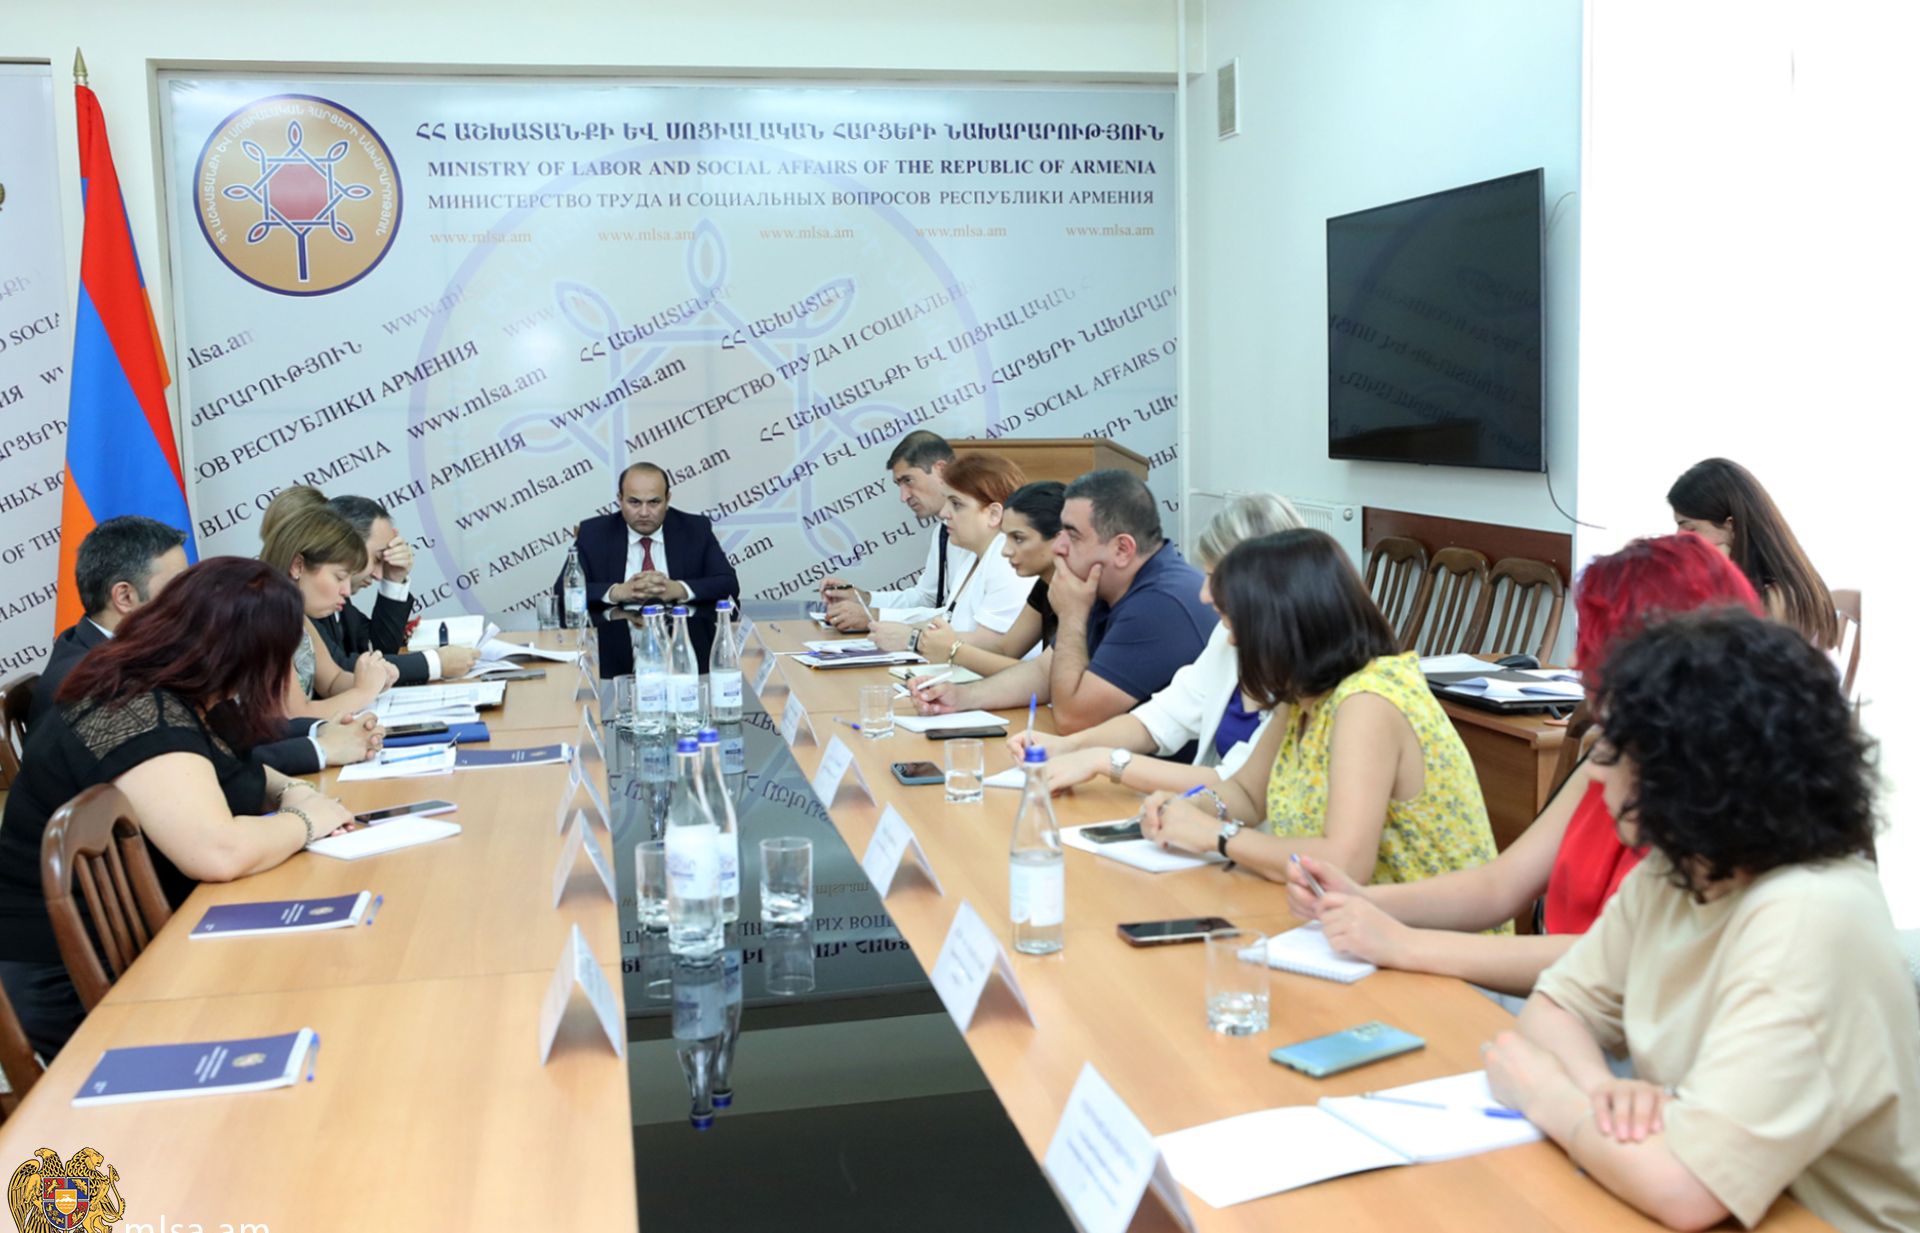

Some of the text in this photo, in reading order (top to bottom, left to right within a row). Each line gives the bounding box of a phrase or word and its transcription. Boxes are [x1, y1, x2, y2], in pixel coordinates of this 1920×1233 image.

[415, 122, 1165, 142] ՀՀ ԱՇԽԱՏԱՆՔԻ ԵՎ ՍՈՑԻԱԼԱԿԱՆ ՀԱՐՑԵՐԻ ՆԱԽԱՐԱՐՈՒԹՅՈՒՆ
[428, 159, 1157, 177] MINISTRY OF LABOR AND SOCIAL AFFAIRS OF THE REPUBLIC OF ARMENIA
[428, 190, 1154, 209] МИНИСТЕРСТВО ТРУДА И СОЦИАЛЬНЫХ ВОПРОСОВ РЕСПУБЛИКИ АРМЕНИЯ
[430, 229, 532, 244] www.mlsa.am
[597, 227, 696, 242] www.mlsa.am
[759, 226, 855, 240] www.mlsa.am
[915, 224, 1007, 238] www.mlsa.am
[1065, 223, 1155, 236] www.mlsa.am
[231, 387, 377, 466] РЕСПУБЛИКИ
[381, 340, 479, 399] АРМЕНИЯ
[406, 365, 548, 441] www.mlsa.am
[550, 357, 687, 431] www.mlsa.am
[624, 372, 776, 453] МИНИСТЕРСТВО
[776, 343, 842, 381] ТРУДА
[759, 421, 785, 442] ՀՀ
[786, 363, 912, 432] ԱՇԽԱՏԱՆՔԻ
[913, 345, 948, 371] ԵՎ
[822, 442, 857, 467] ԵՎ
[991, 336, 1077, 384] ՀԱՐՑԵՐԻ
[985, 415, 1022, 440] AND
[1024, 383, 1089, 422] SOCIAL
[1092, 346, 1161, 392] AFFAIRS
[429, 432, 528, 491] АРМЕНИЯ
[455, 457, 594, 531] www.mlsa.am
[802, 478, 887, 530] MINISTRY
[2, 543, 25, 565] OF
[456, 568, 481, 590] OF
[489, 526, 576, 577] ARMENIA
[881, 521, 916, 545] ԵՎ
